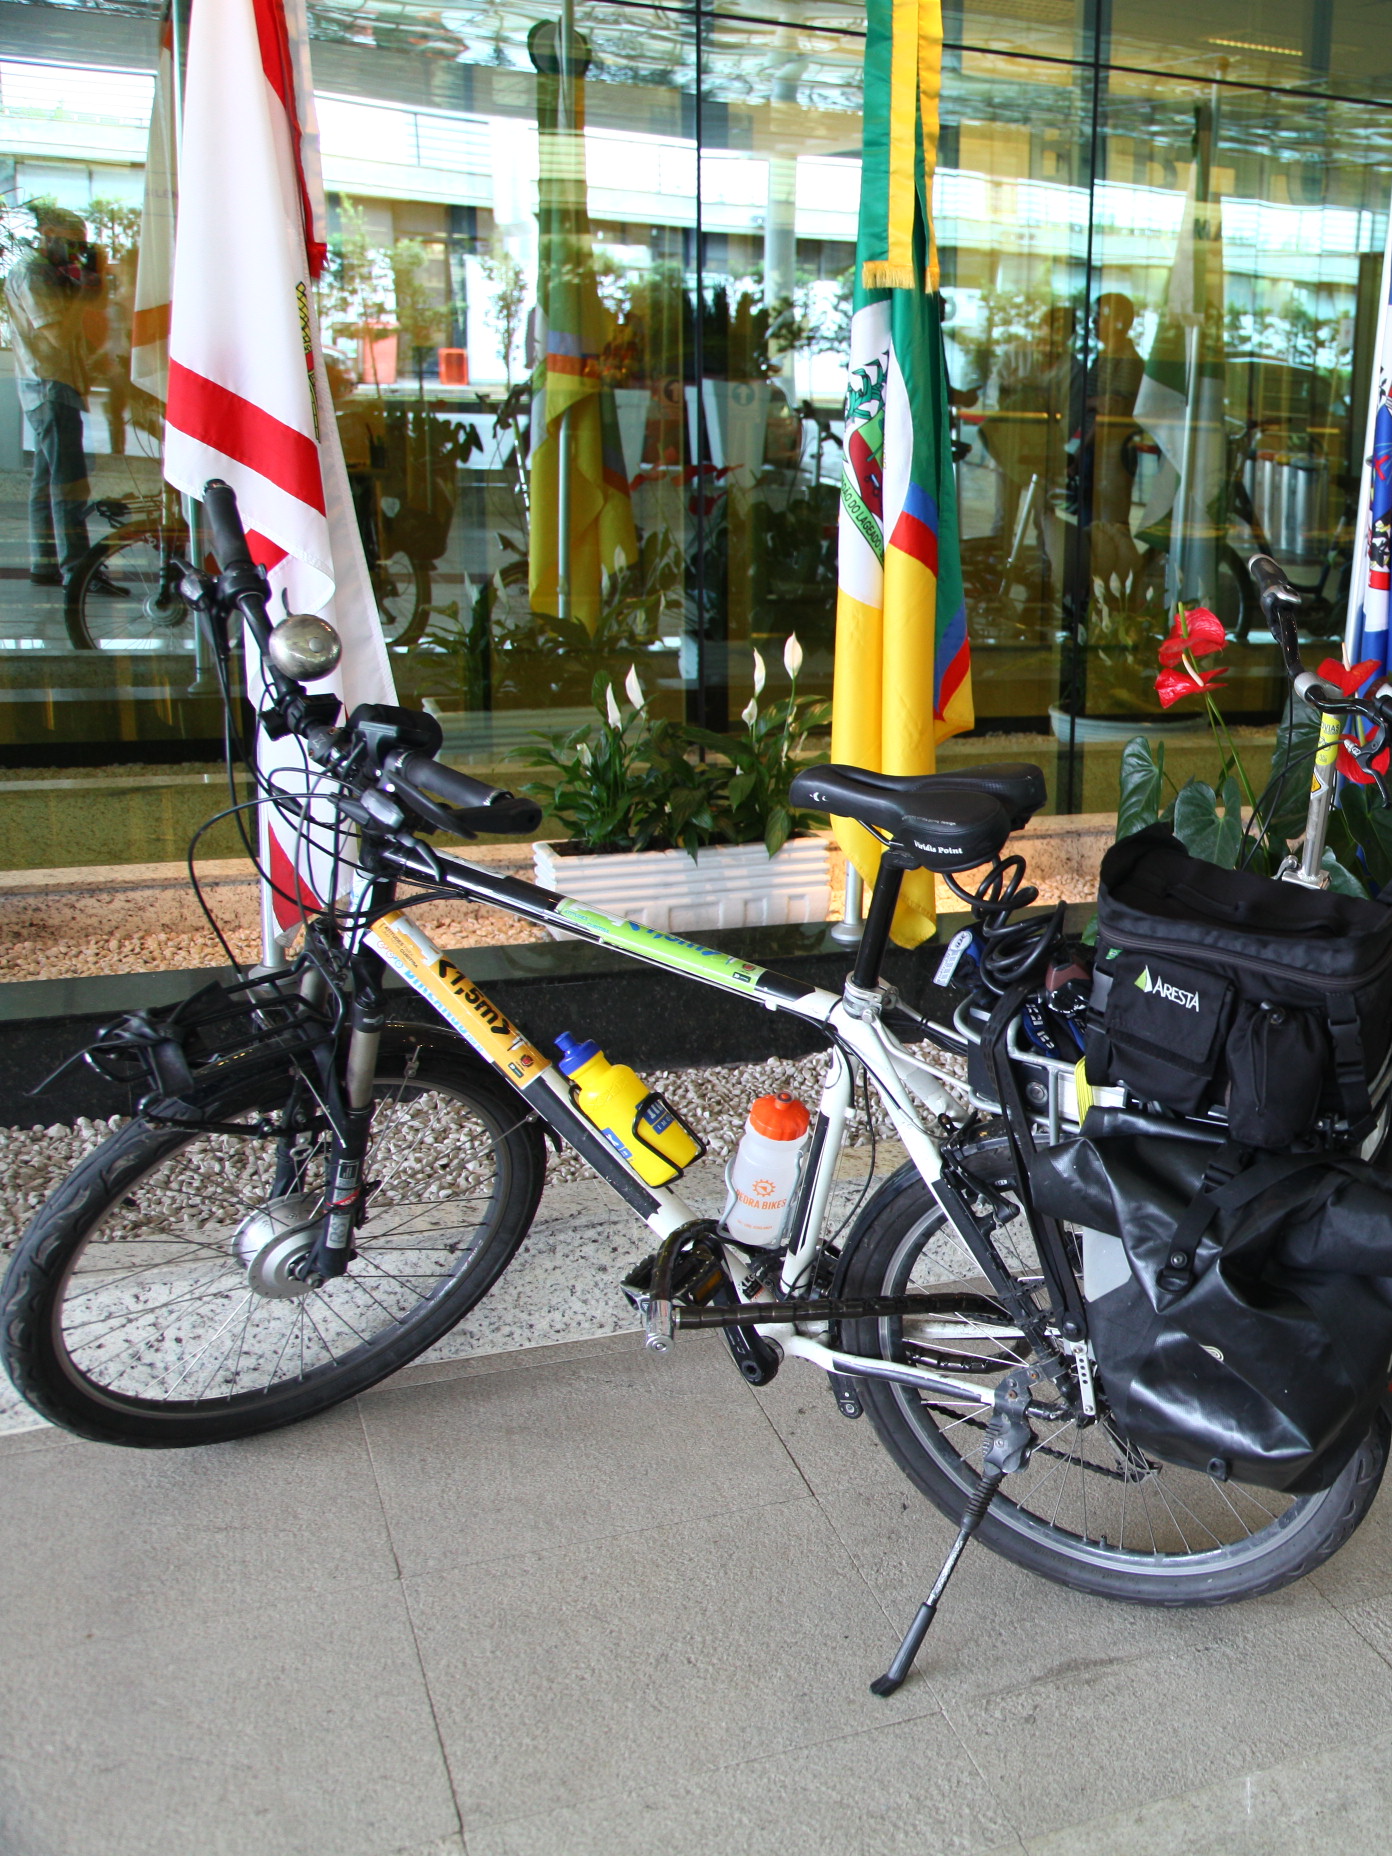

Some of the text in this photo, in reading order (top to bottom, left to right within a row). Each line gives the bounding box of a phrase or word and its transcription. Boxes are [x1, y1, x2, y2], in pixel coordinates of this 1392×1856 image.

[848, 500, 861, 514] DO
[855, 511, 882, 549] LAGEADO
[913, 840, 963, 855] Viridis Point
[1152, 976, 1200, 1013] ARESTA
[761, 1198, 788, 1211] BIKES
